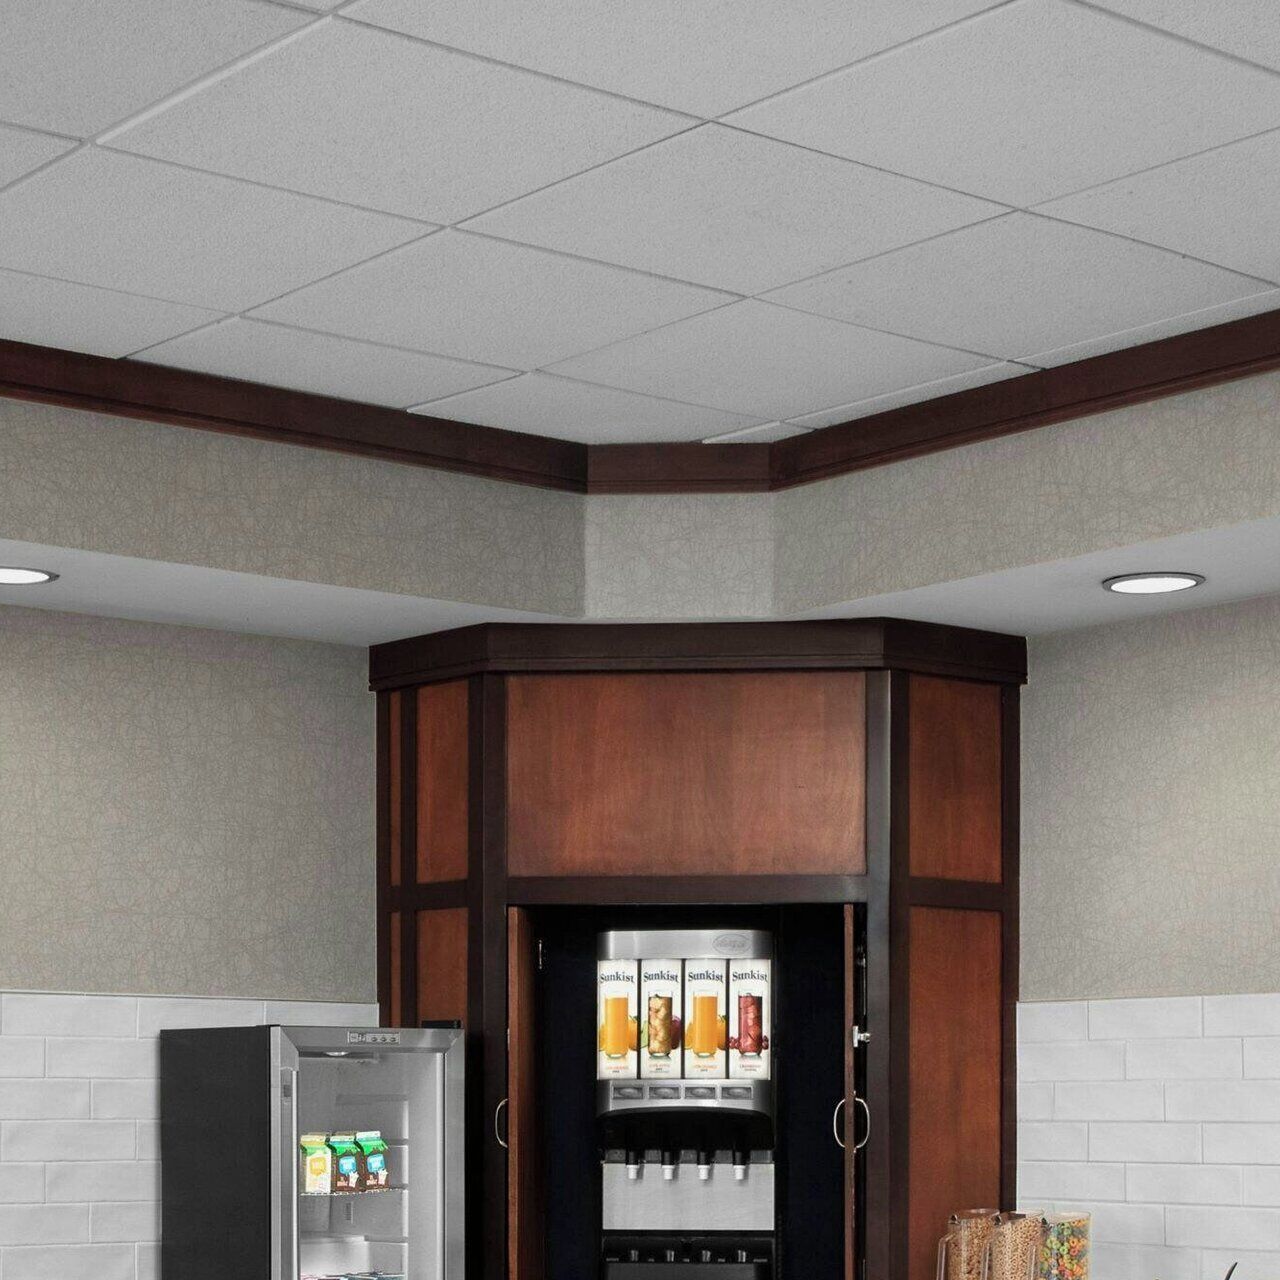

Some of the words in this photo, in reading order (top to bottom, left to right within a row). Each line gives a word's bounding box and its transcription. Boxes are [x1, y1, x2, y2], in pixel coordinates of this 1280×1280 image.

[599, 971, 635, 983] Sunkist
[643, 970, 679, 983] Sunkist
[688, 970, 724, 983] Sunkist
[732, 970, 769, 983] Sunkist
